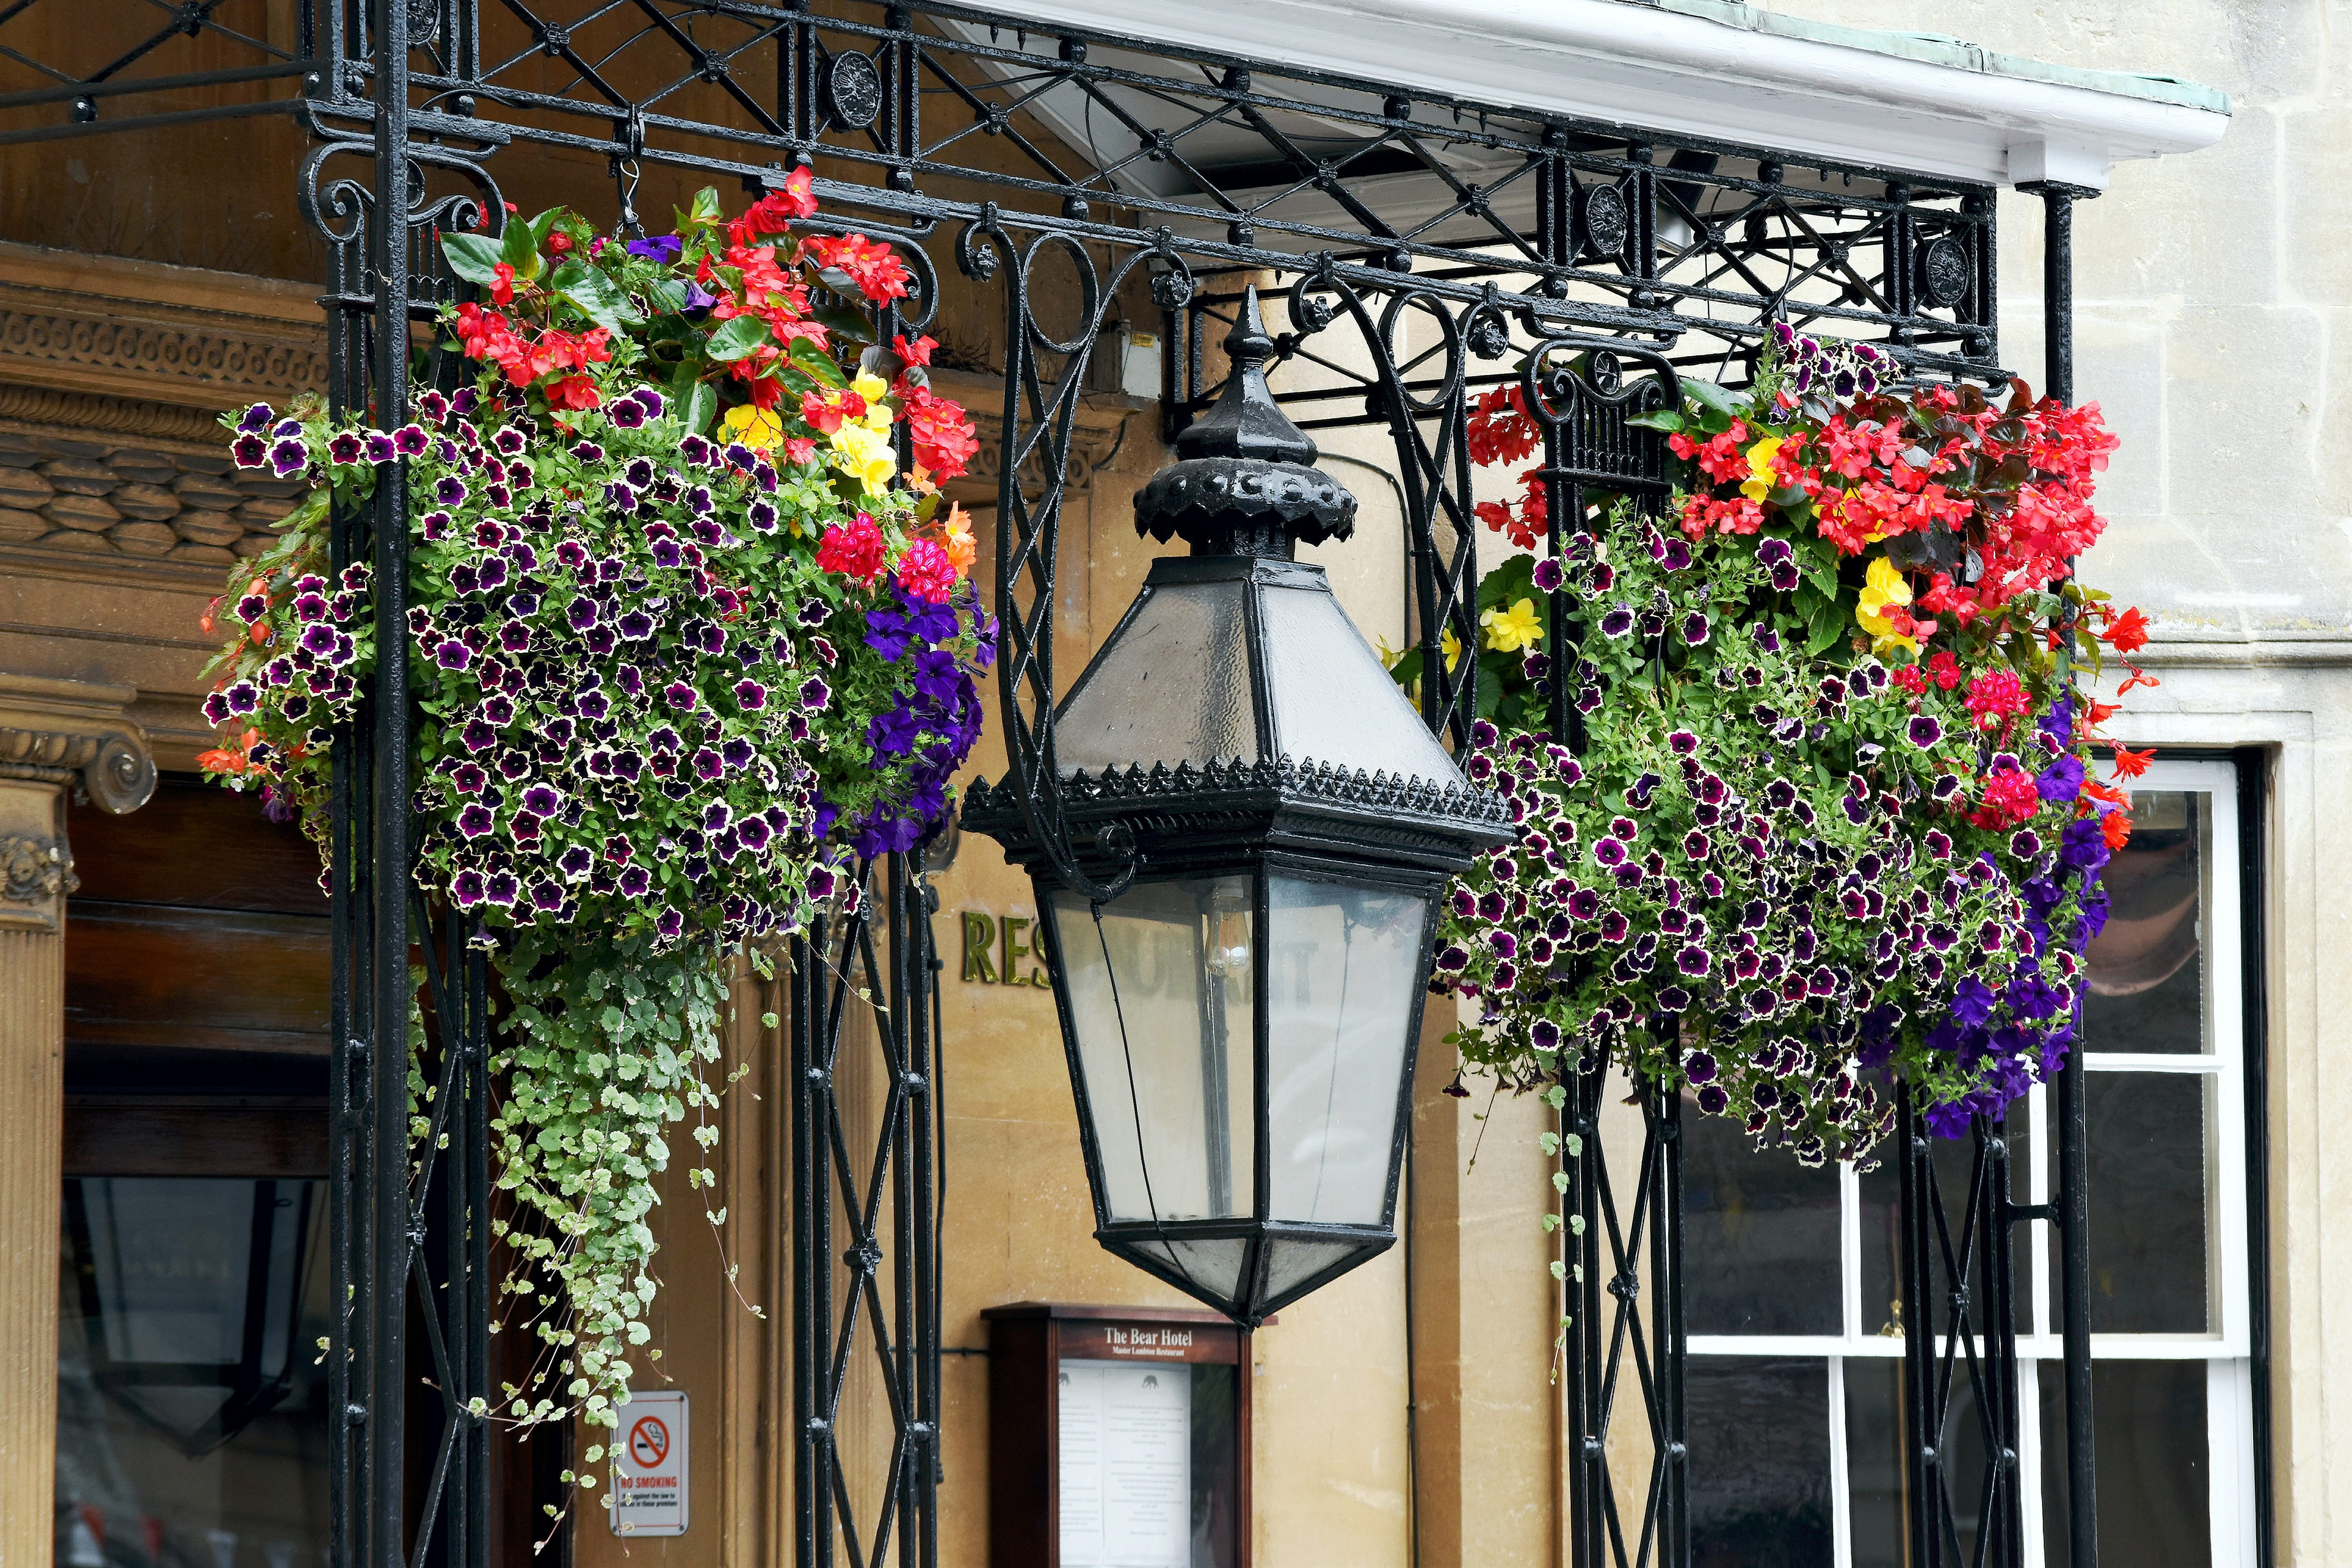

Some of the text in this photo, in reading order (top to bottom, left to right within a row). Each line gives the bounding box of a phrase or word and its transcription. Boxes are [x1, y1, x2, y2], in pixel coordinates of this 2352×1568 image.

[1105, 1327, 1192, 1346] The Bear Hotel
[1156, 1347, 1184, 1356] Restaurant
[621, 1476, 677, 1488] NO SMOKING
